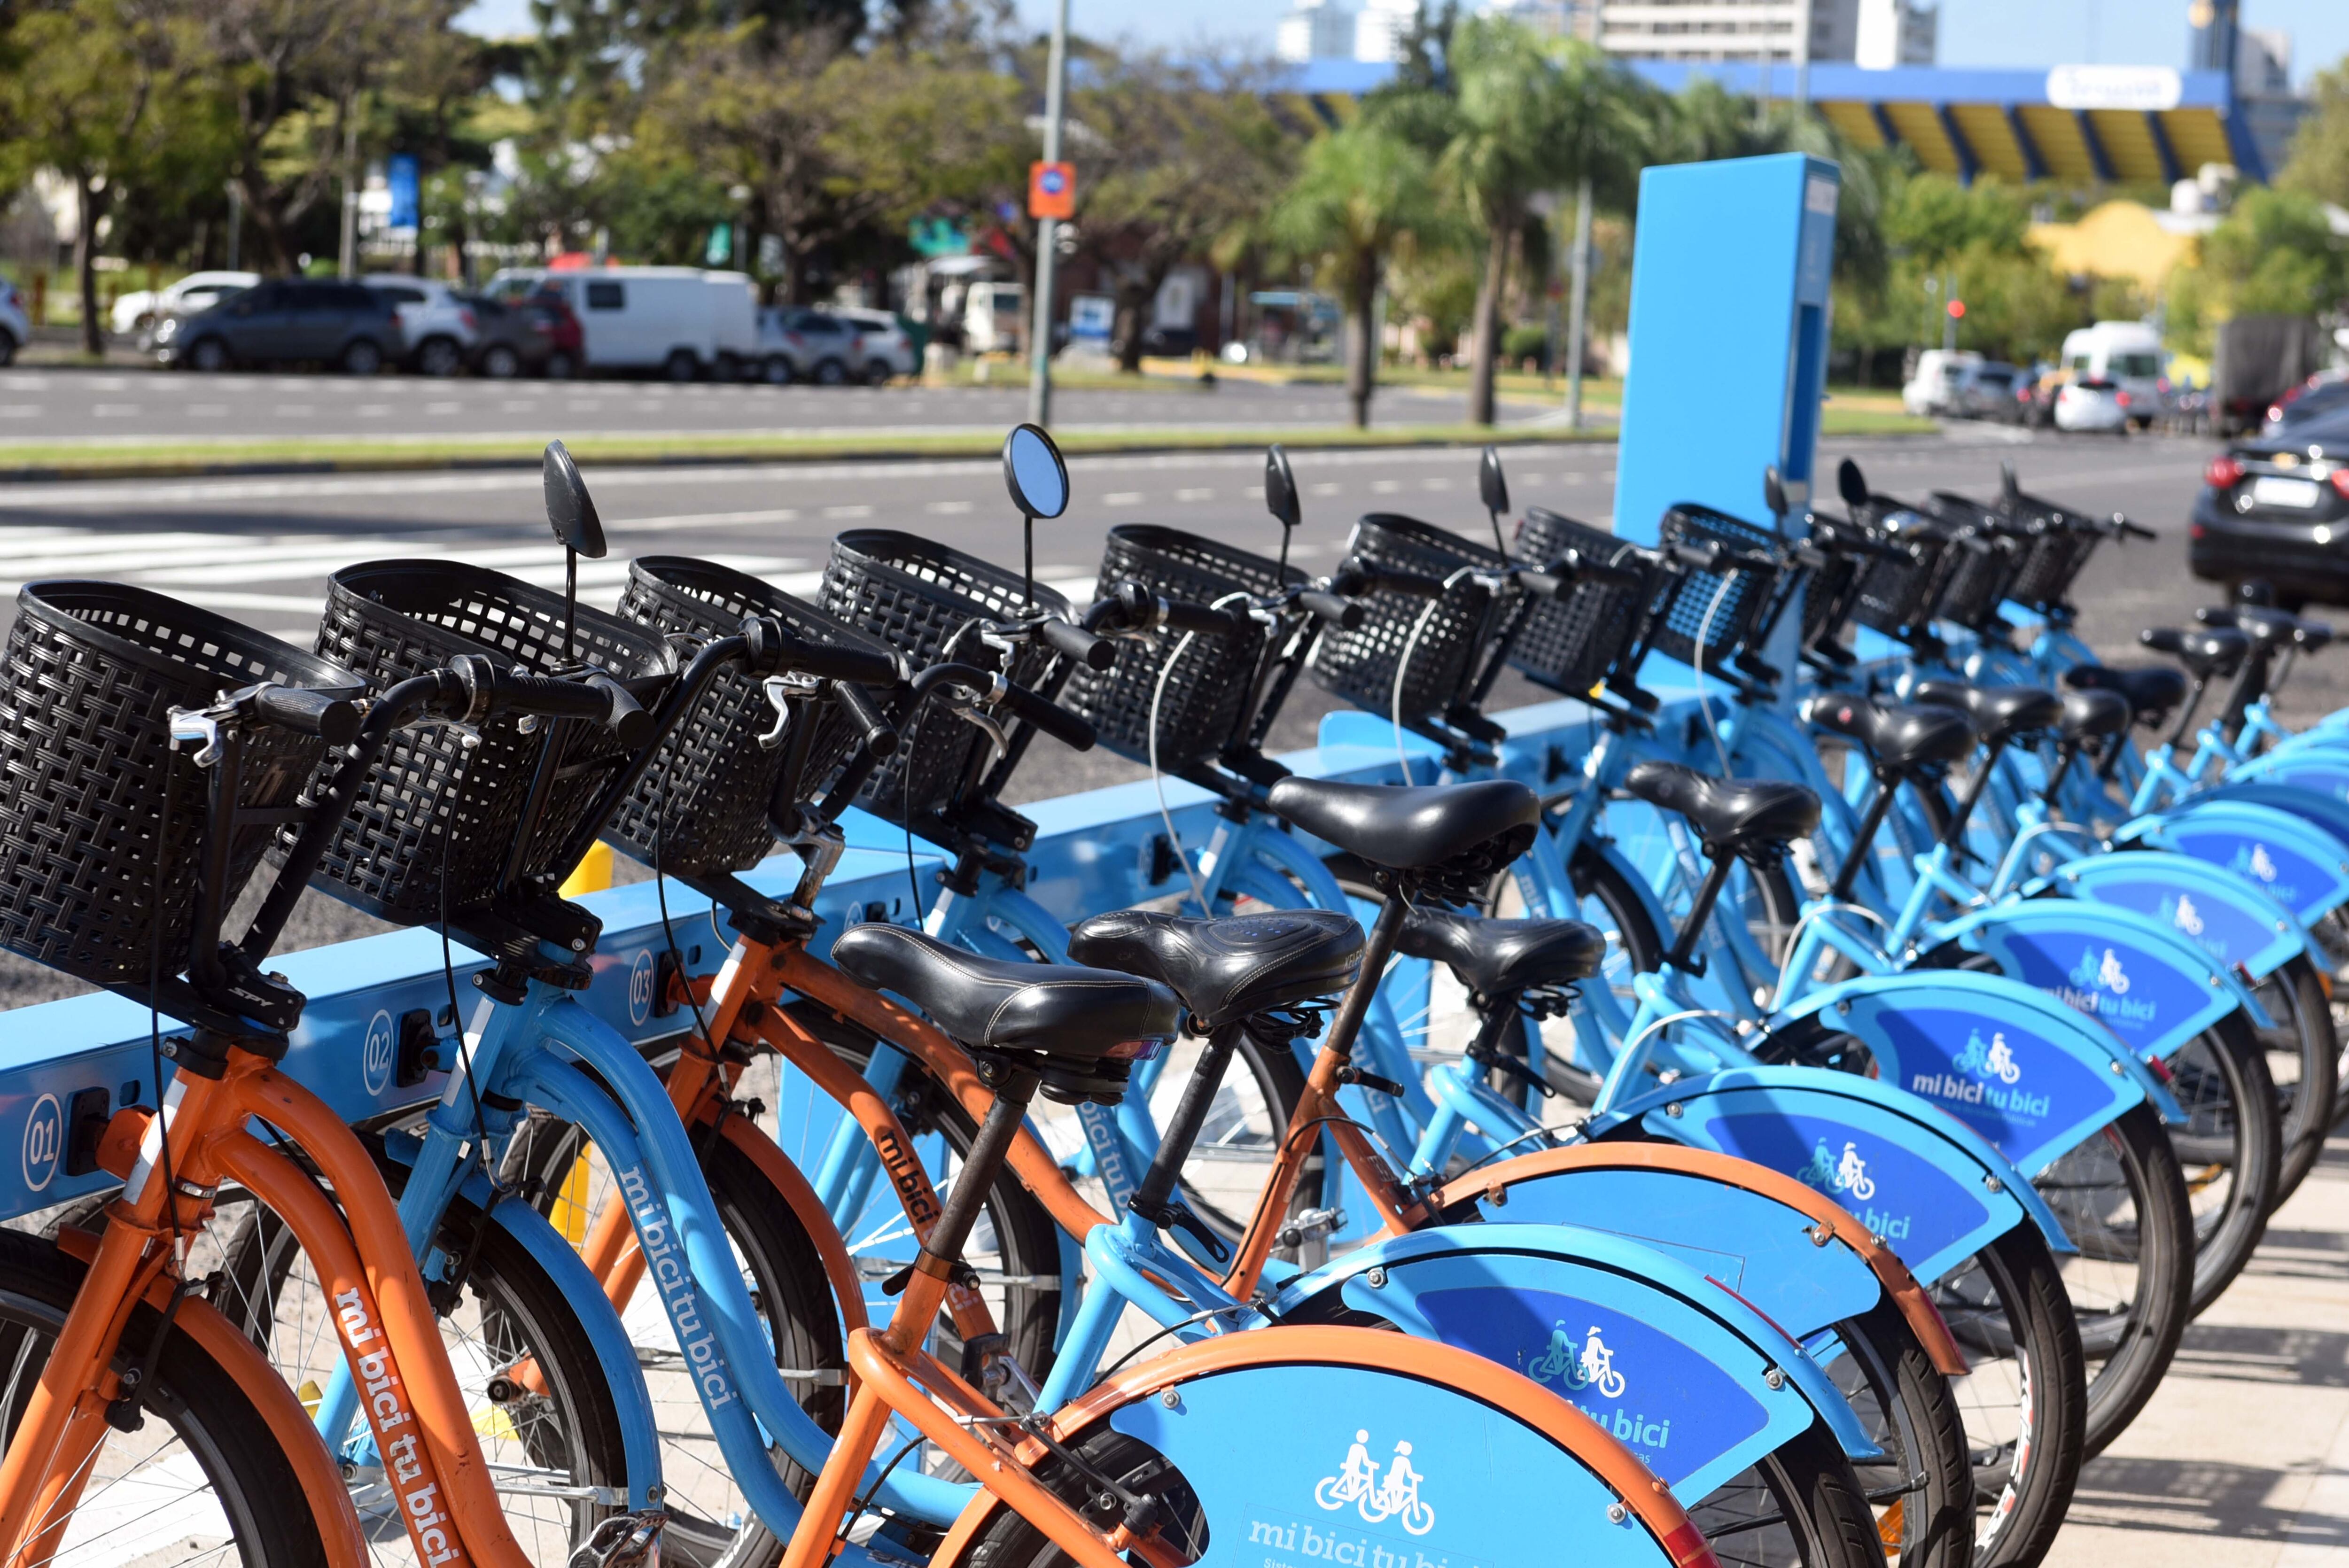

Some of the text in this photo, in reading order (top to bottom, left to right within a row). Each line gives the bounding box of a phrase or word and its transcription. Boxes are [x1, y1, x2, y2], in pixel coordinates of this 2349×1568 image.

[227, 986, 275, 1007] SPY
[634, 969, 651, 1005] 03
[369, 1031, 390, 1072] 02
[1912, 1073, 1943, 1096] mi
[1943, 1074, 1985, 1104] bici
[1985, 1086, 2008, 1110] tu
[2009, 1087, 2051, 1118] bici
[30, 1118, 54, 1165] 01
[880, 1129, 940, 1225] mi bici
[1101, 1151, 1125, 1188] tu
[1865, 1207, 1911, 1240] bici
[619, 1165, 738, 1410] mi bici tu bici
[335, 1287, 460, 1568] mi bici tu bici
[1612, 1408, 1670, 1448] bici
[1248, 1520, 1298, 1552] mi
[1301, 1525, 1367, 1568] bici
